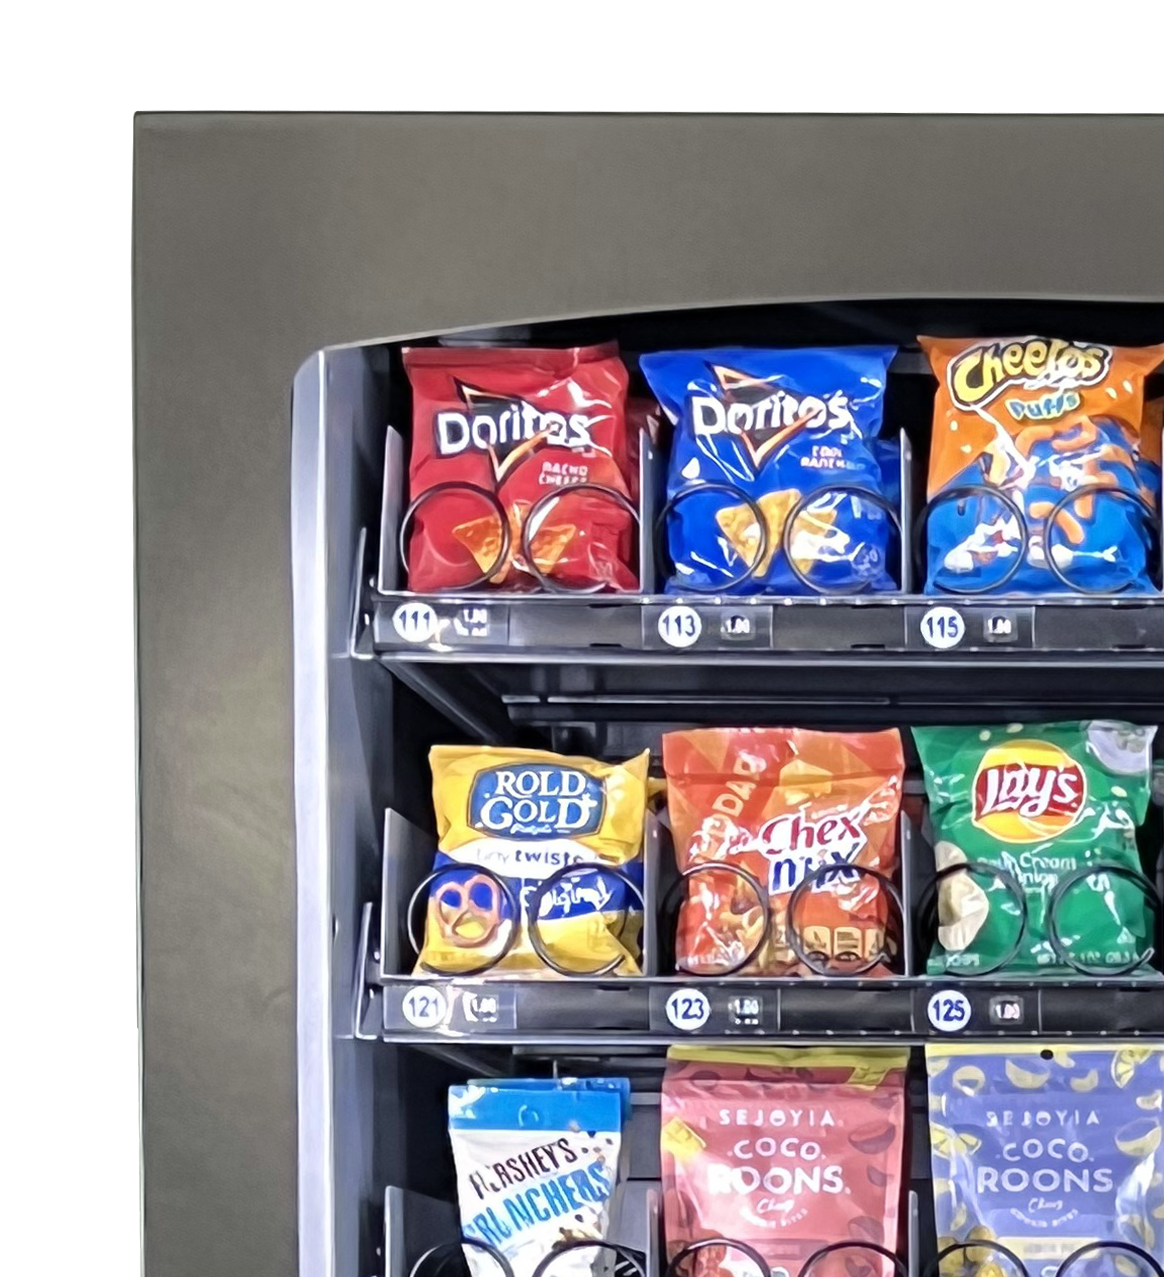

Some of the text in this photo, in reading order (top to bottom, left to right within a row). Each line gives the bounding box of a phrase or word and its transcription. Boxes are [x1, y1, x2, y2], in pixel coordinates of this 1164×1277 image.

[953, 338, 1104, 403] Cheetos
[692, 388, 852, 435] Doritos
[437, 402, 592, 454] Doritos
[400, 610, 430, 632] 111
[663, 615, 696, 636] 113
[927, 616, 958, 638] 115
[496, 770, 586, 798] ROLD
[980, 763, 1078, 818] Lay's
[481, 796, 592, 829] GOLD
[762, 815, 860, 853] Chex
[409, 996, 439, 1017] 121
[671, 998, 704, 1019] 123
[932, 998, 964, 1022] 125
[719, 1109, 835, 1126] SEJOYIA
[734, 1138, 821, 1160] COCO
[1003, 1138, 1089, 1162] COCO
[705, 1165, 843, 1195] ROONS
[977, 1167, 1113, 1193] ROONS
